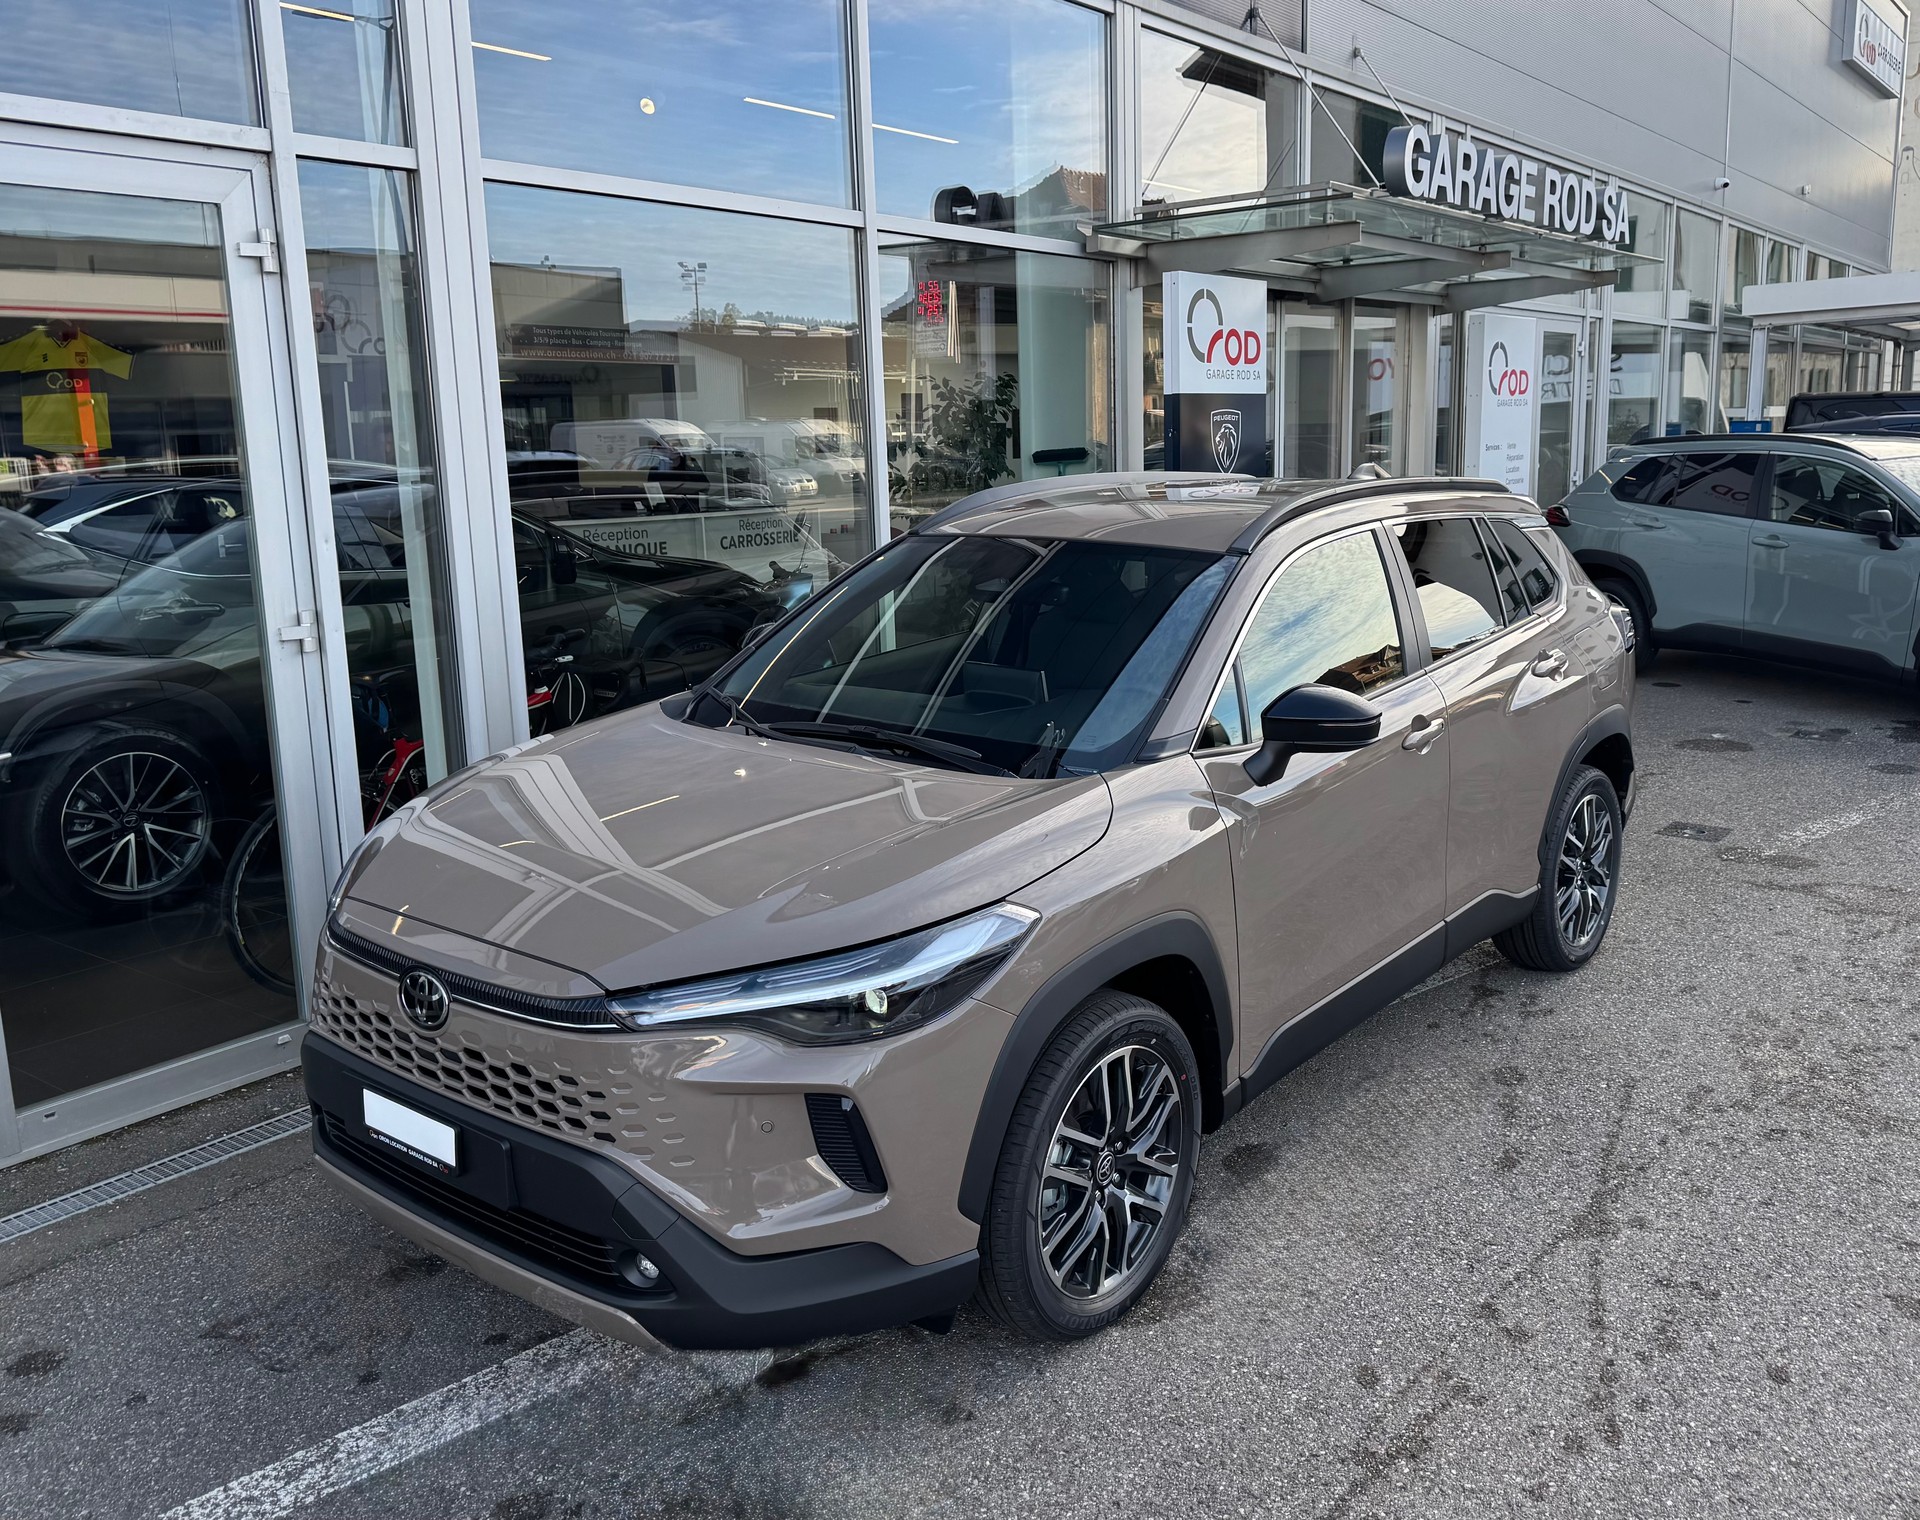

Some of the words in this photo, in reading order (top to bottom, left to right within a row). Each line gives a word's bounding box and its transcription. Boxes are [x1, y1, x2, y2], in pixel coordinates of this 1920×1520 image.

[1402, 124, 1538, 223] GARAGE
[1543, 166, 1597, 236] ROD
[1602, 185, 1630, 245] SA
[533, 327, 549, 335] Tous
[550, 328, 563, 337] types
[1206, 368, 1235, 380] GARAGE
[1236, 369, 1251, 381] ROD
[1252, 370, 1261, 381] SA
[1497, 398, 1513, 407] GARAGE
[1213, 413, 1239, 422] PEUGEOT
[738, 516, 783, 532] Réception
[583, 528, 648, 543] Réception
[720, 530, 799, 550] CARROSSERIE
[408, 1149, 424, 1161] GARAGE
